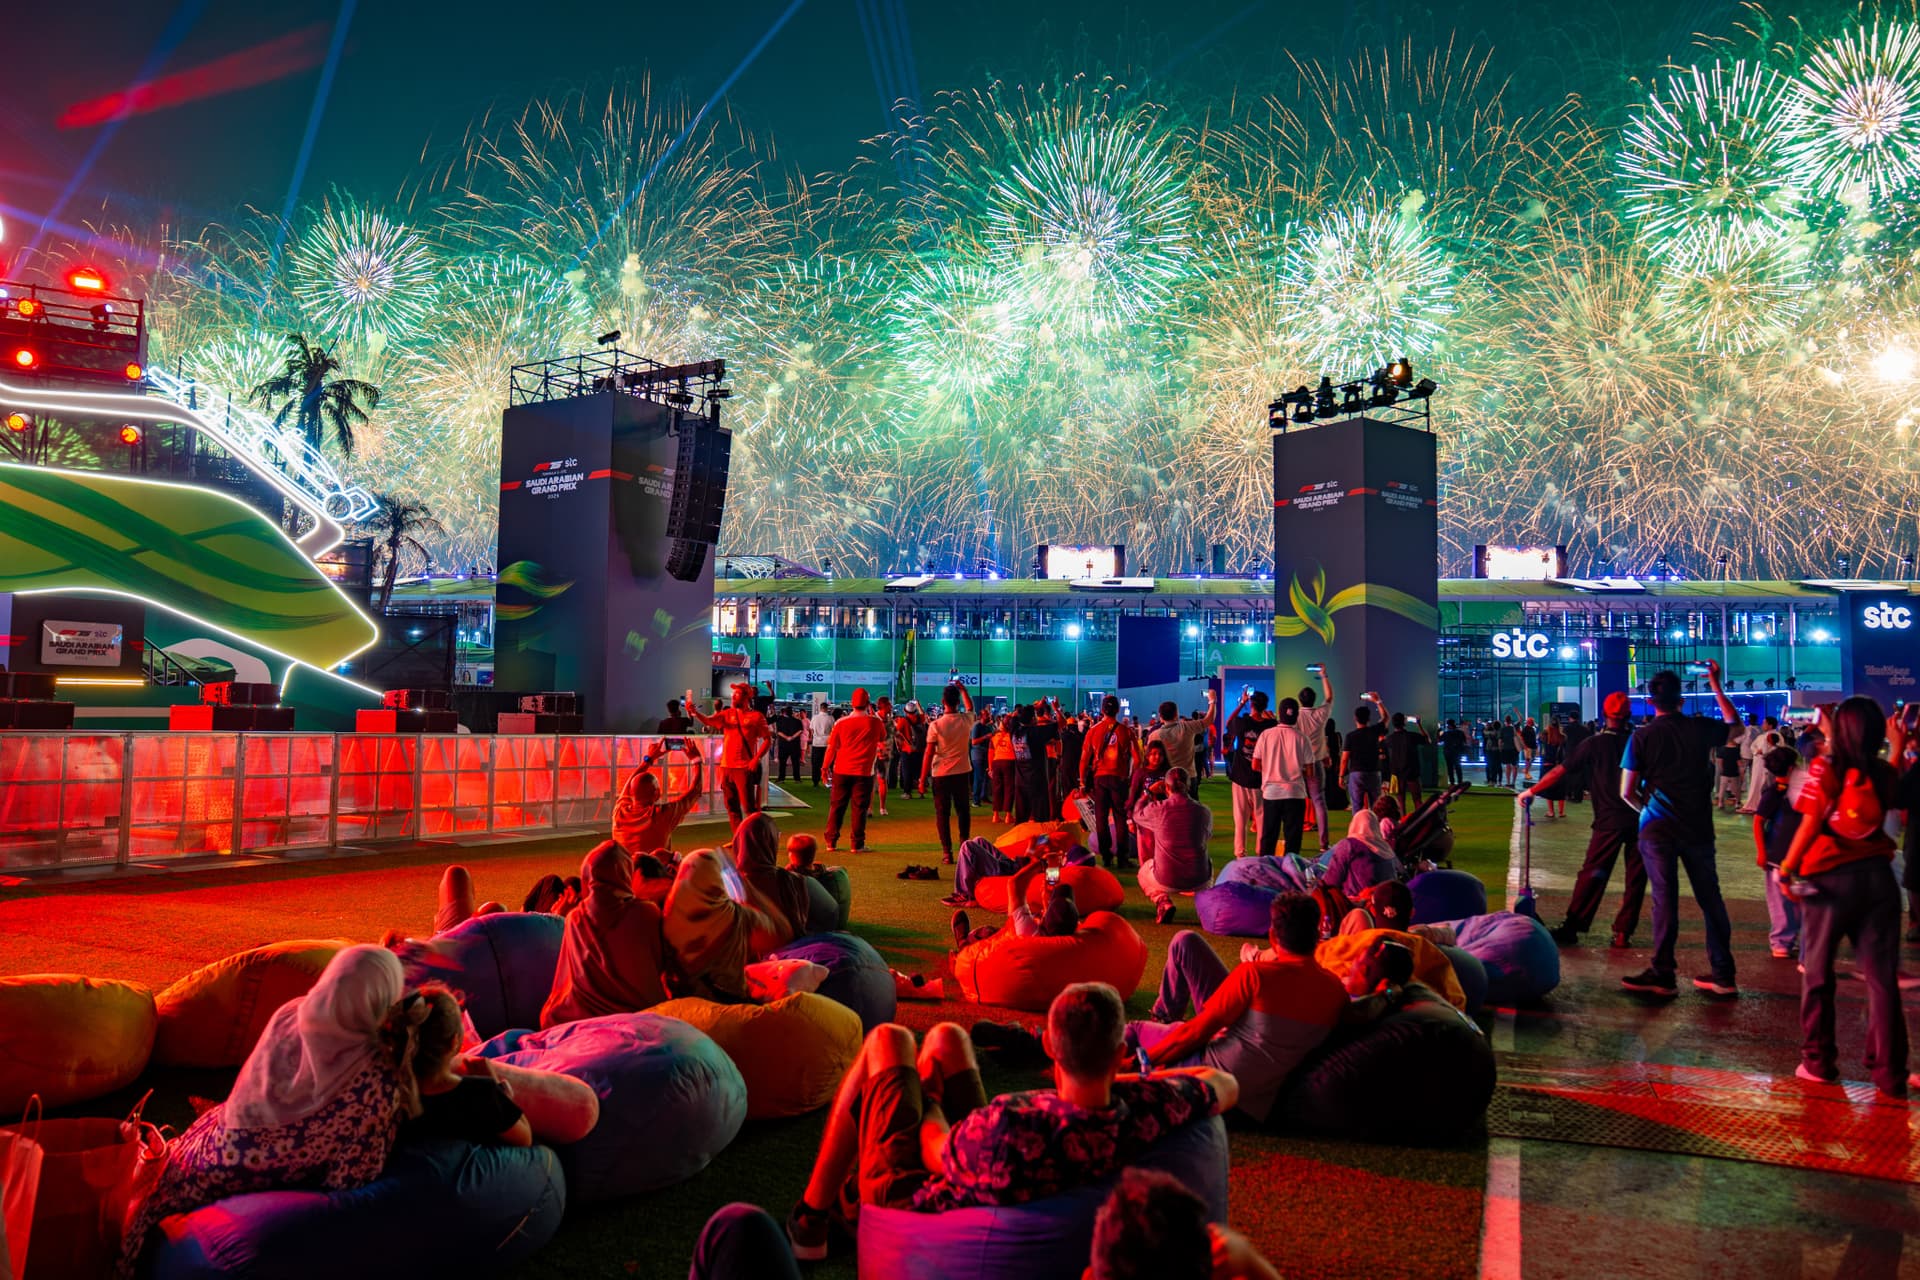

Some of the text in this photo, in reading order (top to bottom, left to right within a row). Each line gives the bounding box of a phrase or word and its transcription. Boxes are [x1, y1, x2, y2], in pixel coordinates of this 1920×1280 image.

[525, 477, 548, 488] SAUDI
[548, 472, 584, 486] ARABIAN
[638, 476, 661, 489] SAUDI
[531, 481, 577, 495] GRAND PRIX
[1293, 496, 1312, 504] SAUDI
[1312, 491, 1344, 501] ARABIAN
[1298, 501, 1322, 510] GRAND
[1322, 498, 1339, 506] PRIX
[1864, 602, 1911, 629] stc
[48, 640, 74, 649] SAUDI
[75, 641, 115, 650] ARABIAN
[1492, 628, 1549, 658] stc
[56, 647, 107, 656] GRAND PRIX
[805, 671, 824, 682] stc
[959, 674, 978, 685] stc
